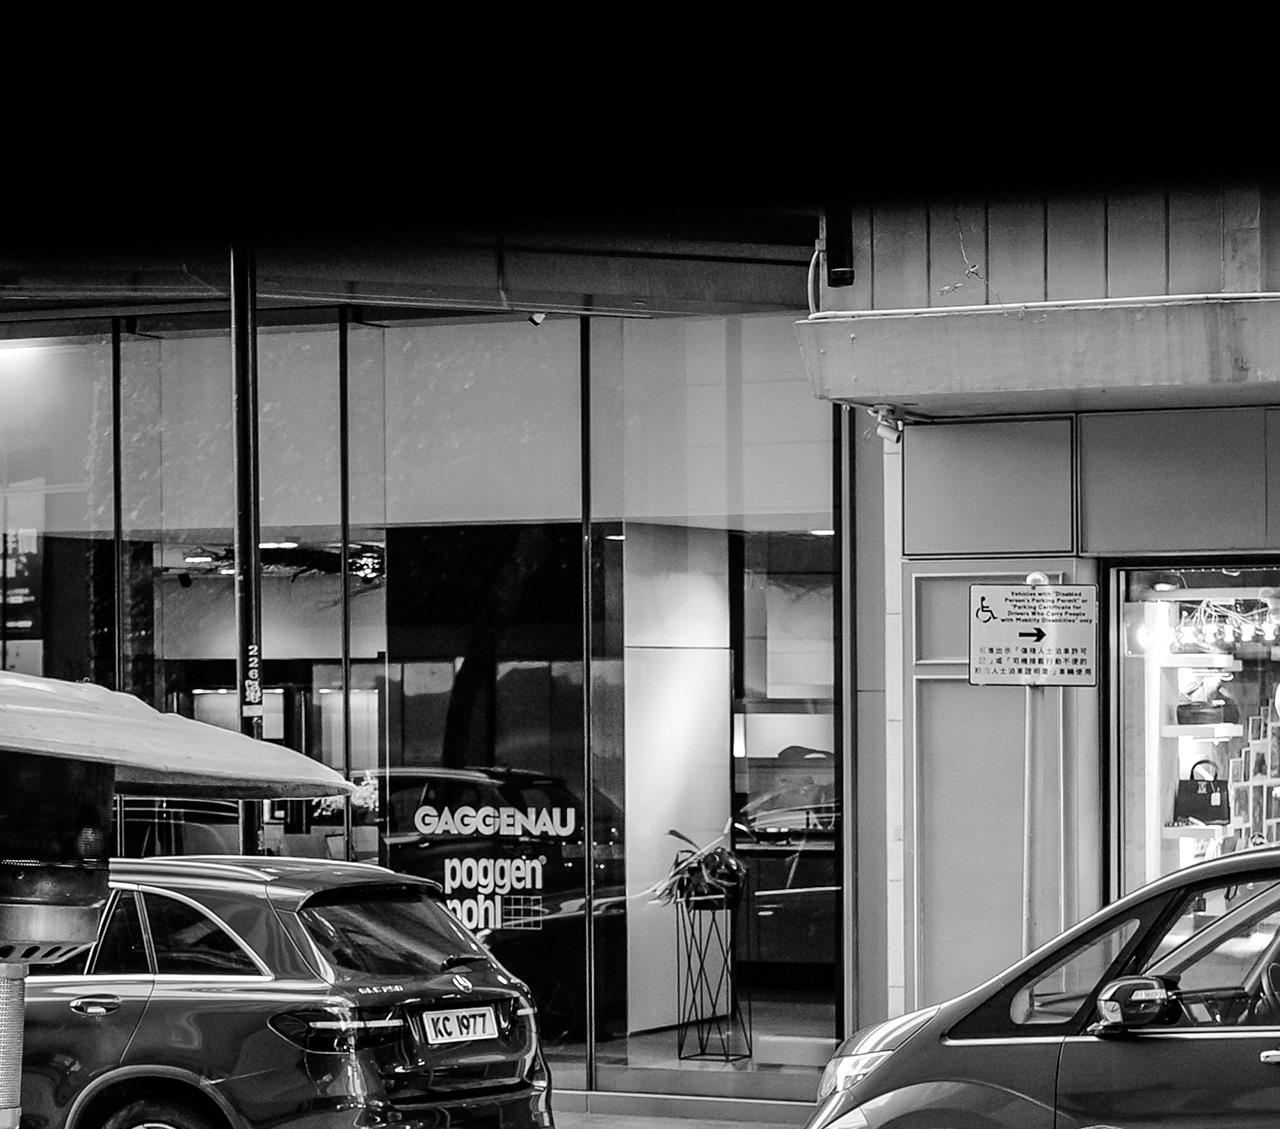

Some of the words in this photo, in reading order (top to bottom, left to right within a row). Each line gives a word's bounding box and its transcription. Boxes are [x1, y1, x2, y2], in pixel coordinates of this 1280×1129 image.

[414, 805, 576, 836] GAGGENAU
[444, 856, 543, 895] poggen
[431, 1016, 454, 1038] KC
[457, 1012, 488, 1035] 1977
